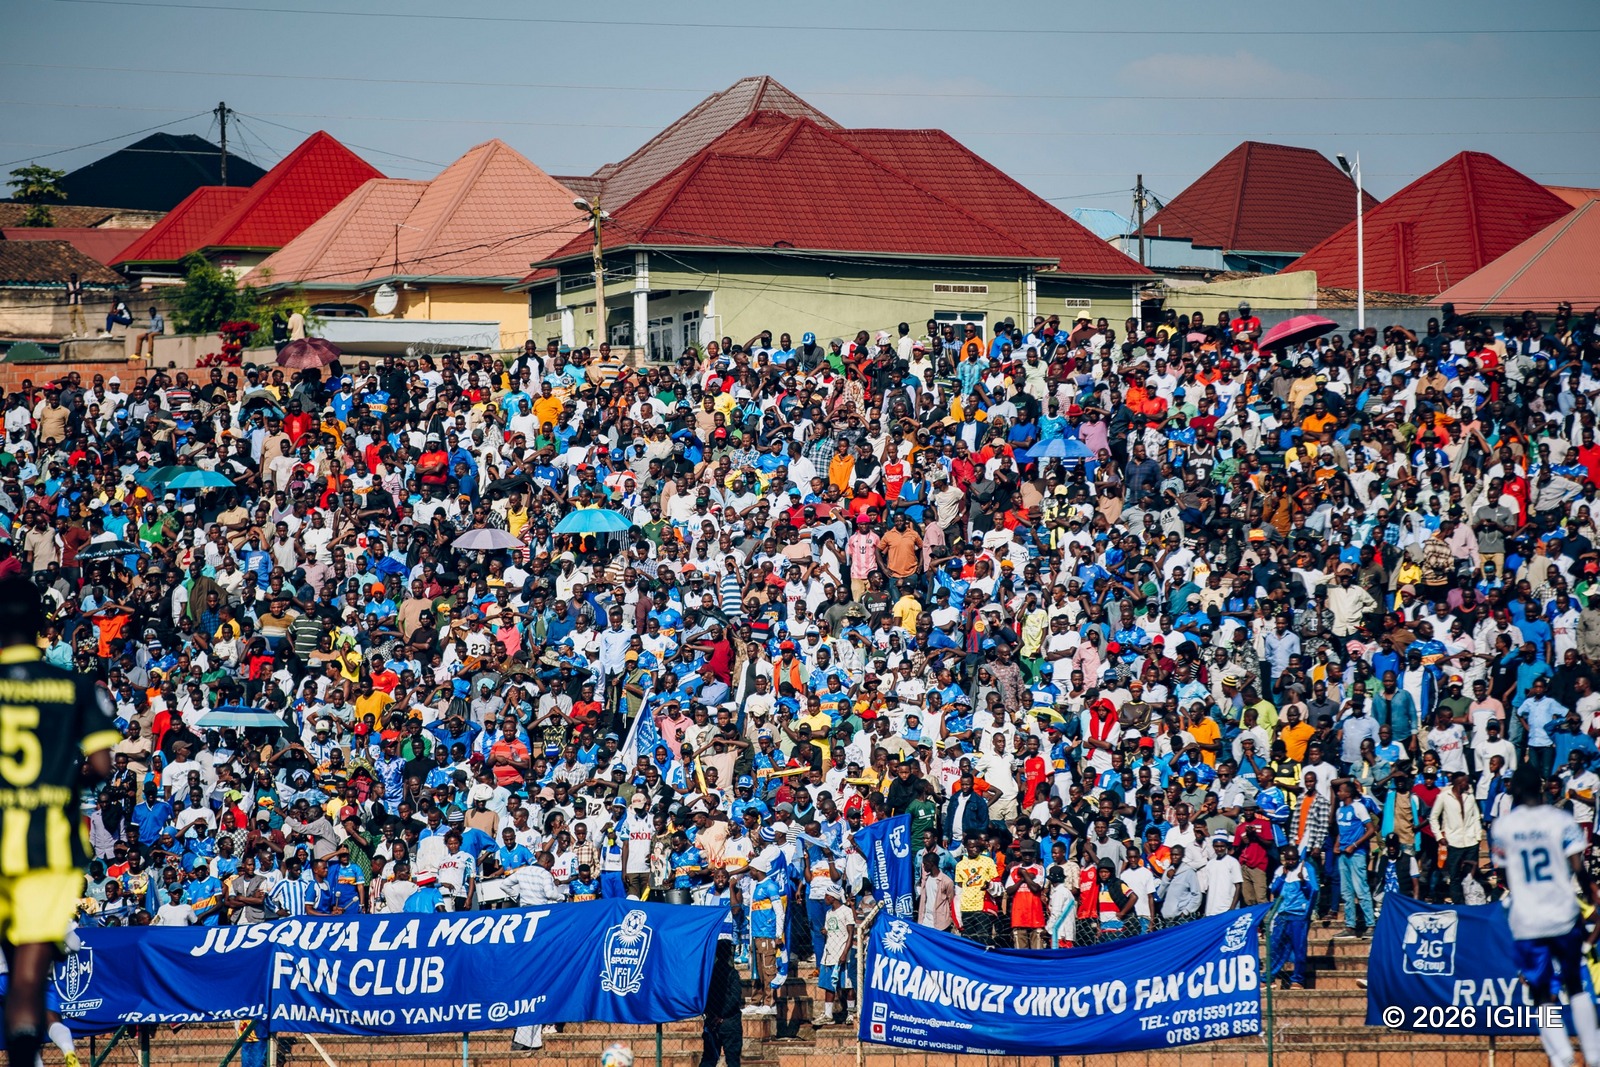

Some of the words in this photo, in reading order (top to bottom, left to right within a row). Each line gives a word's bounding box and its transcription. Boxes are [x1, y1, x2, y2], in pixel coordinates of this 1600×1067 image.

[471, 643, 486, 656] 23
[0, 705, 42, 787] 5
[630, 832, 652, 841] SKOL
[551, 868, 568, 877] KOL
[875, 840, 890, 890] GIKUNDIRO
[1520, 847, 1553, 883] 12
[368, 919, 419, 951] LA
[428, 910, 551, 947] MORT
[614, 947, 639, 957] RAYON
[1416, 939, 1443, 958] 4G
[610, 956, 639, 965] SPORTS
[273, 951, 341, 996] FAN
[348, 956, 445, 996] CLUB
[871, 953, 1008, 1014] KIRAMURUZI
[1013, 980, 1127, 1018] UMUCYO
[1134, 971, 1185, 1010] FAN
[1187, 954, 1258, 1000] CLUB
[271, 1003, 396, 1026] AMAHITAMO
[401, 1003, 482, 1025] YANJYE
[1139, 1014, 1169, 1031] TEL:
[1172, 1000, 1258, 1024] 07815591222
[891, 1025, 928, 1036] PARTNER:
[1166, 1026, 1200, 1044] 0783
[1204, 1022, 1229, 1039] 238
[1233, 1018, 1258, 1035] 856
[893, 1036, 917, 1046] HEART
[929, 1042, 964, 1051] WORSHIP
